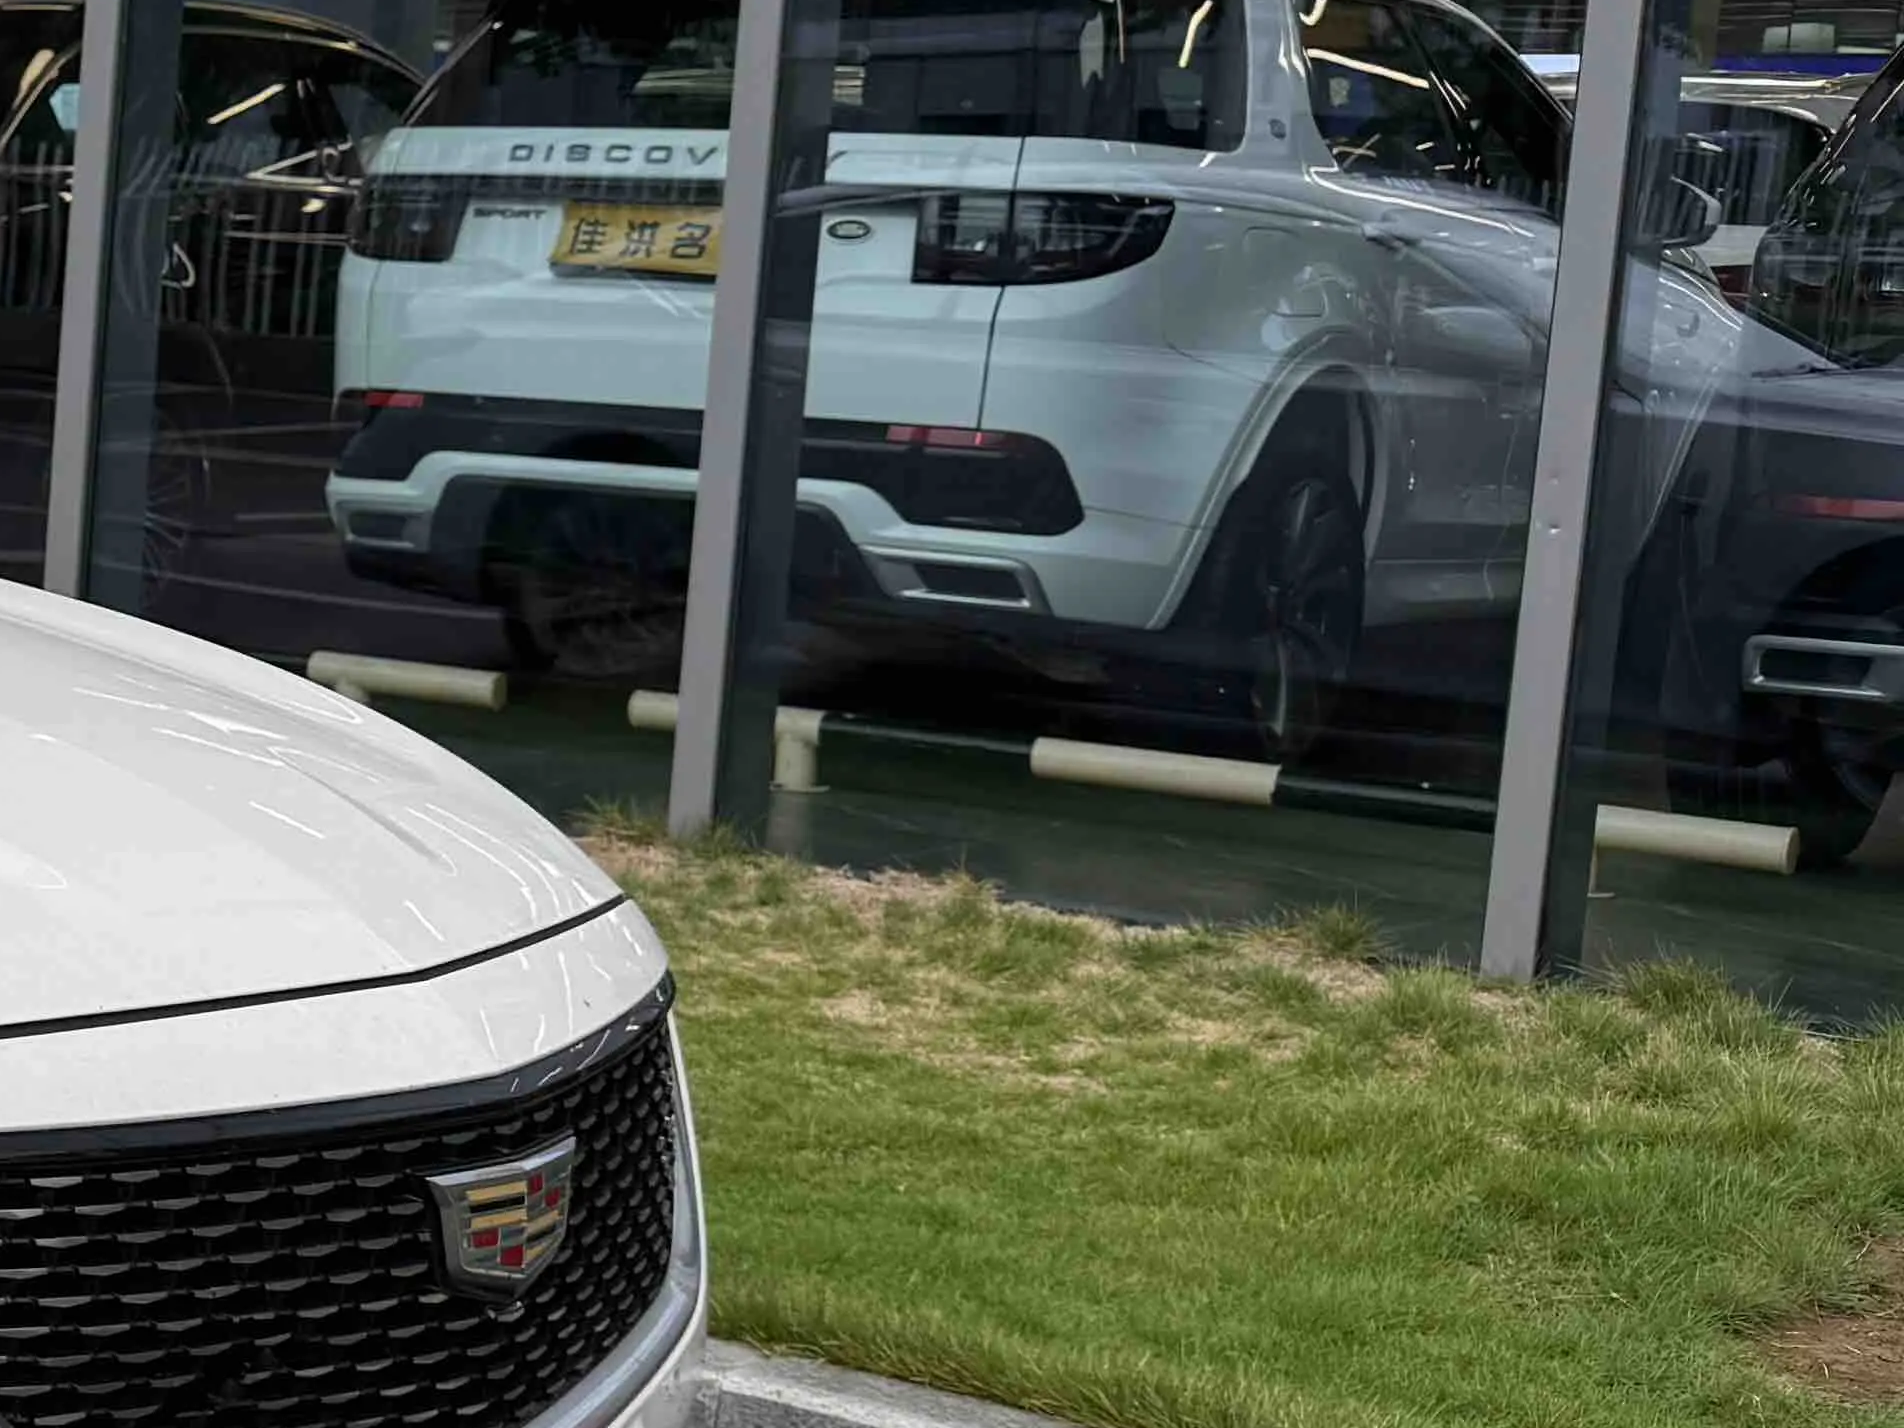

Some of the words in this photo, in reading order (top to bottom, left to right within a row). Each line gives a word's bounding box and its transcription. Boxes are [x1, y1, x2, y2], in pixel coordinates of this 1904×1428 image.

[508, 144, 722, 165] DISCOV
[570, 217, 712, 260] 佳洪名
